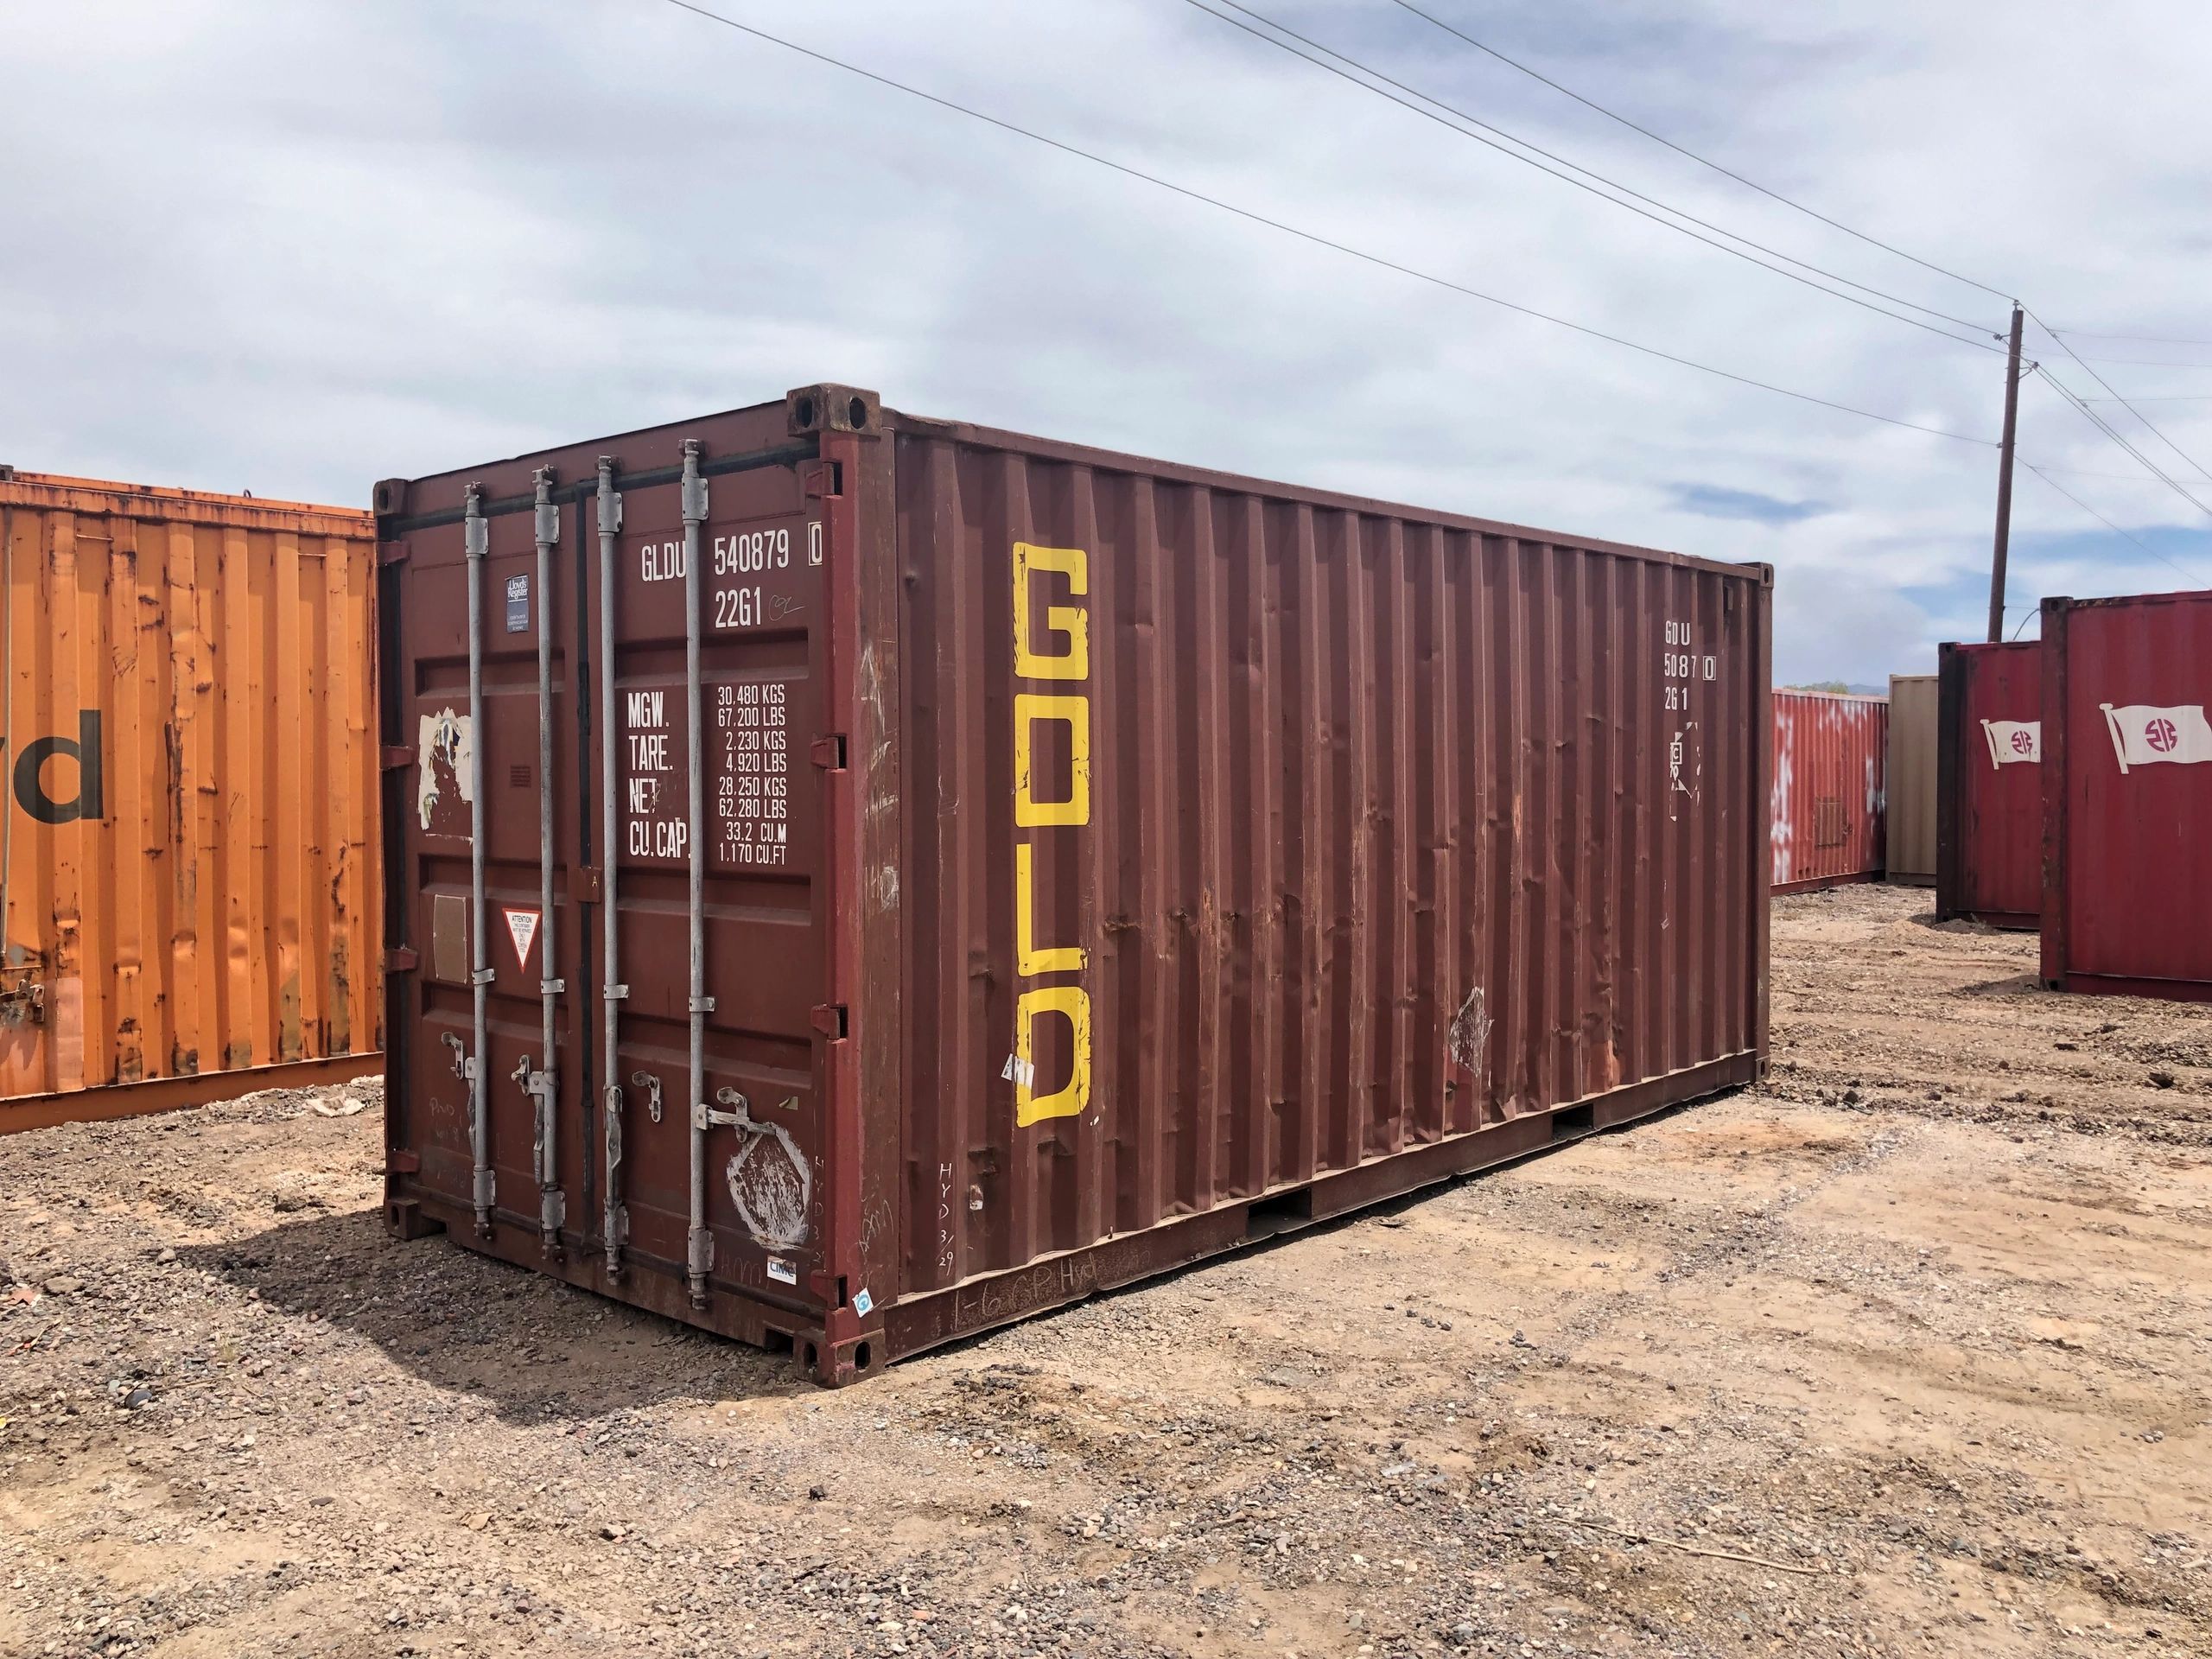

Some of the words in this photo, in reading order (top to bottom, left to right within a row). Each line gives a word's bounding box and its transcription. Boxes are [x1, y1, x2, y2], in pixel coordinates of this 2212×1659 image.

[641, 540, 687, 582] GLDU
[715, 529, 790, 575] 540879
[810, 524, 823, 563] 0
[715, 587, 761, 628] 22G1
[1665, 620, 1691, 645] GDU
[718, 685, 759, 705] 30,480
[762, 684, 785, 704] KGS
[627, 691, 670, 728] MGW.
[718, 708, 759, 727] 67,200
[763, 707, 785, 726] LBS
[726, 731, 760, 750] 2,230
[764, 731, 786, 750] KGS
[628, 734, 673, 771] TARE.
[726, 753, 760, 772] 4,920
[764, 753, 787, 772] LBS
[719, 776, 760, 796] 28,250
[764, 777, 787, 797] KGS
[719, 798, 760, 818] 62,280
[764, 798, 787, 819] LBS
[726, 821, 752, 842] 33.2
[760, 823, 787, 843] CU.M
[1013, 542, 1091, 1128] GOLD
[719, 842, 752, 862] 1,170
[756, 844, 787, 865] CU.FT
